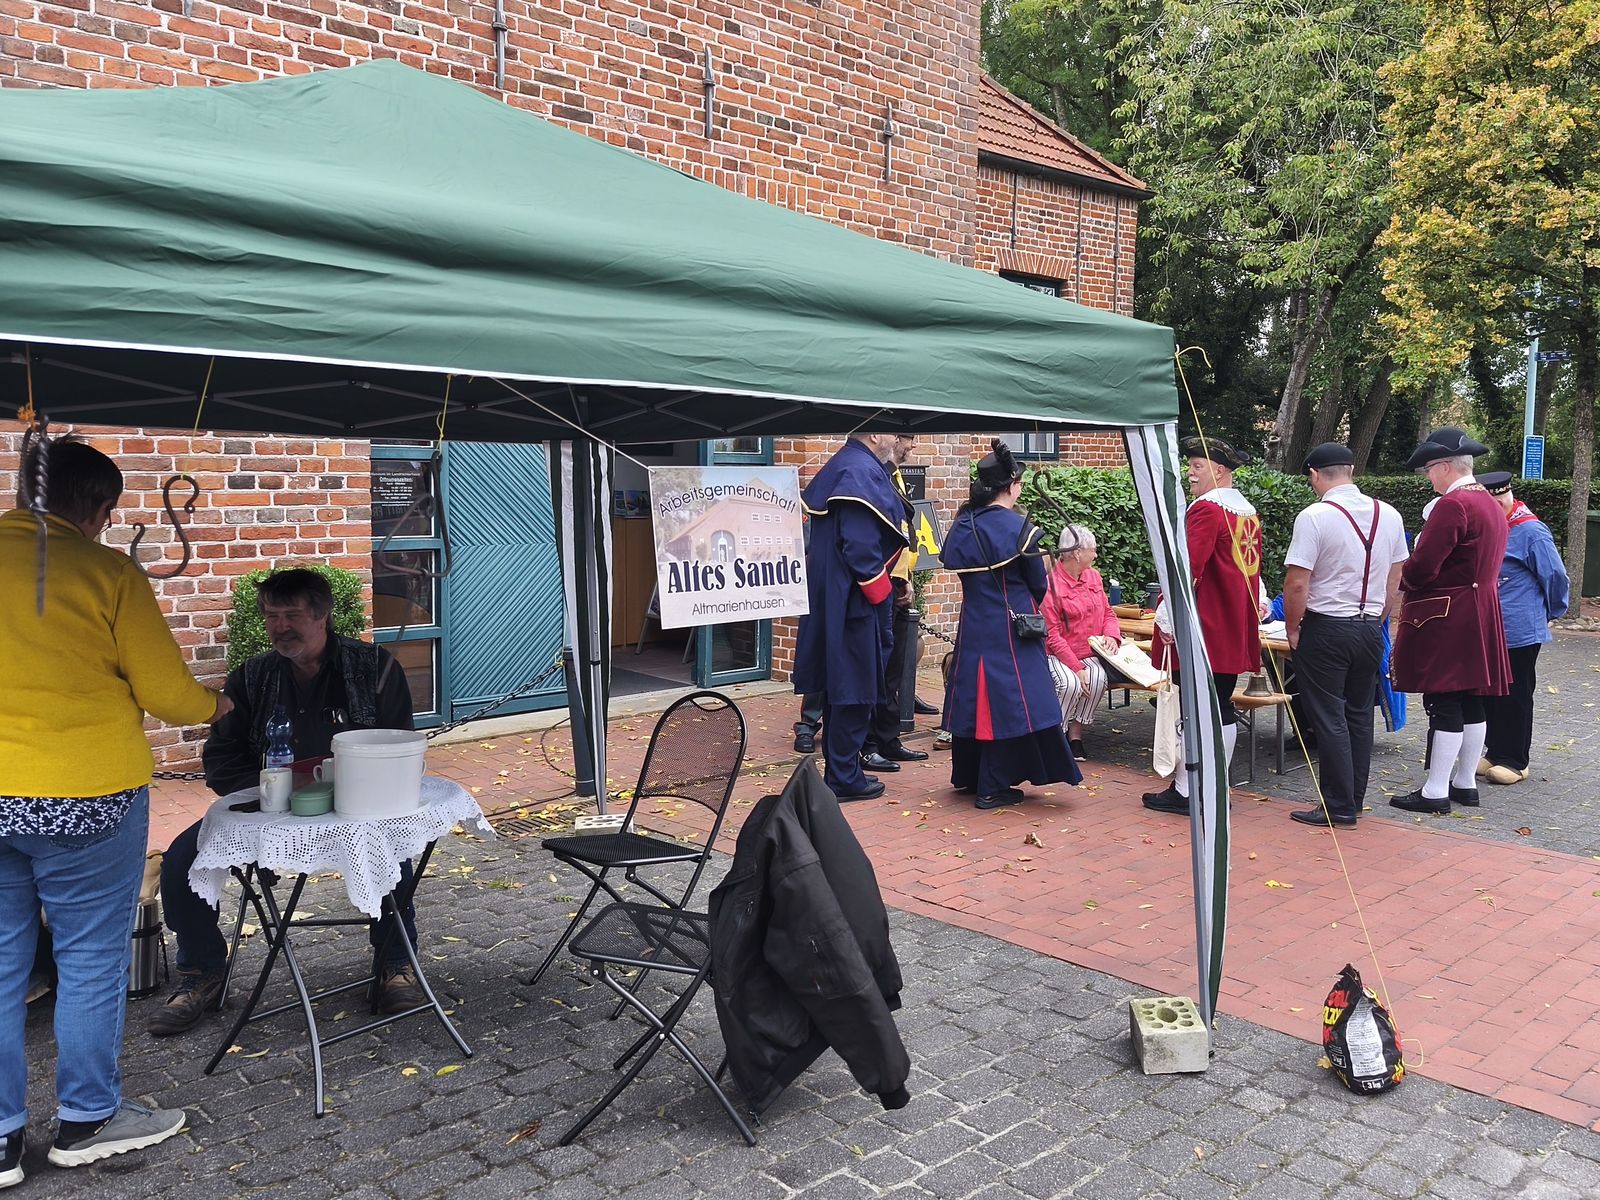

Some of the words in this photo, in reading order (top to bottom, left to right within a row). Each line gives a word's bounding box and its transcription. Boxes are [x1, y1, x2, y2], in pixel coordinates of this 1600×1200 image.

[658, 483, 797, 518] Arbeitsgemeinschaft
[667, 559, 726, 594] Altes
[733, 555, 802, 589] Sande
[691, 597, 786, 616] Altmarienhausen
